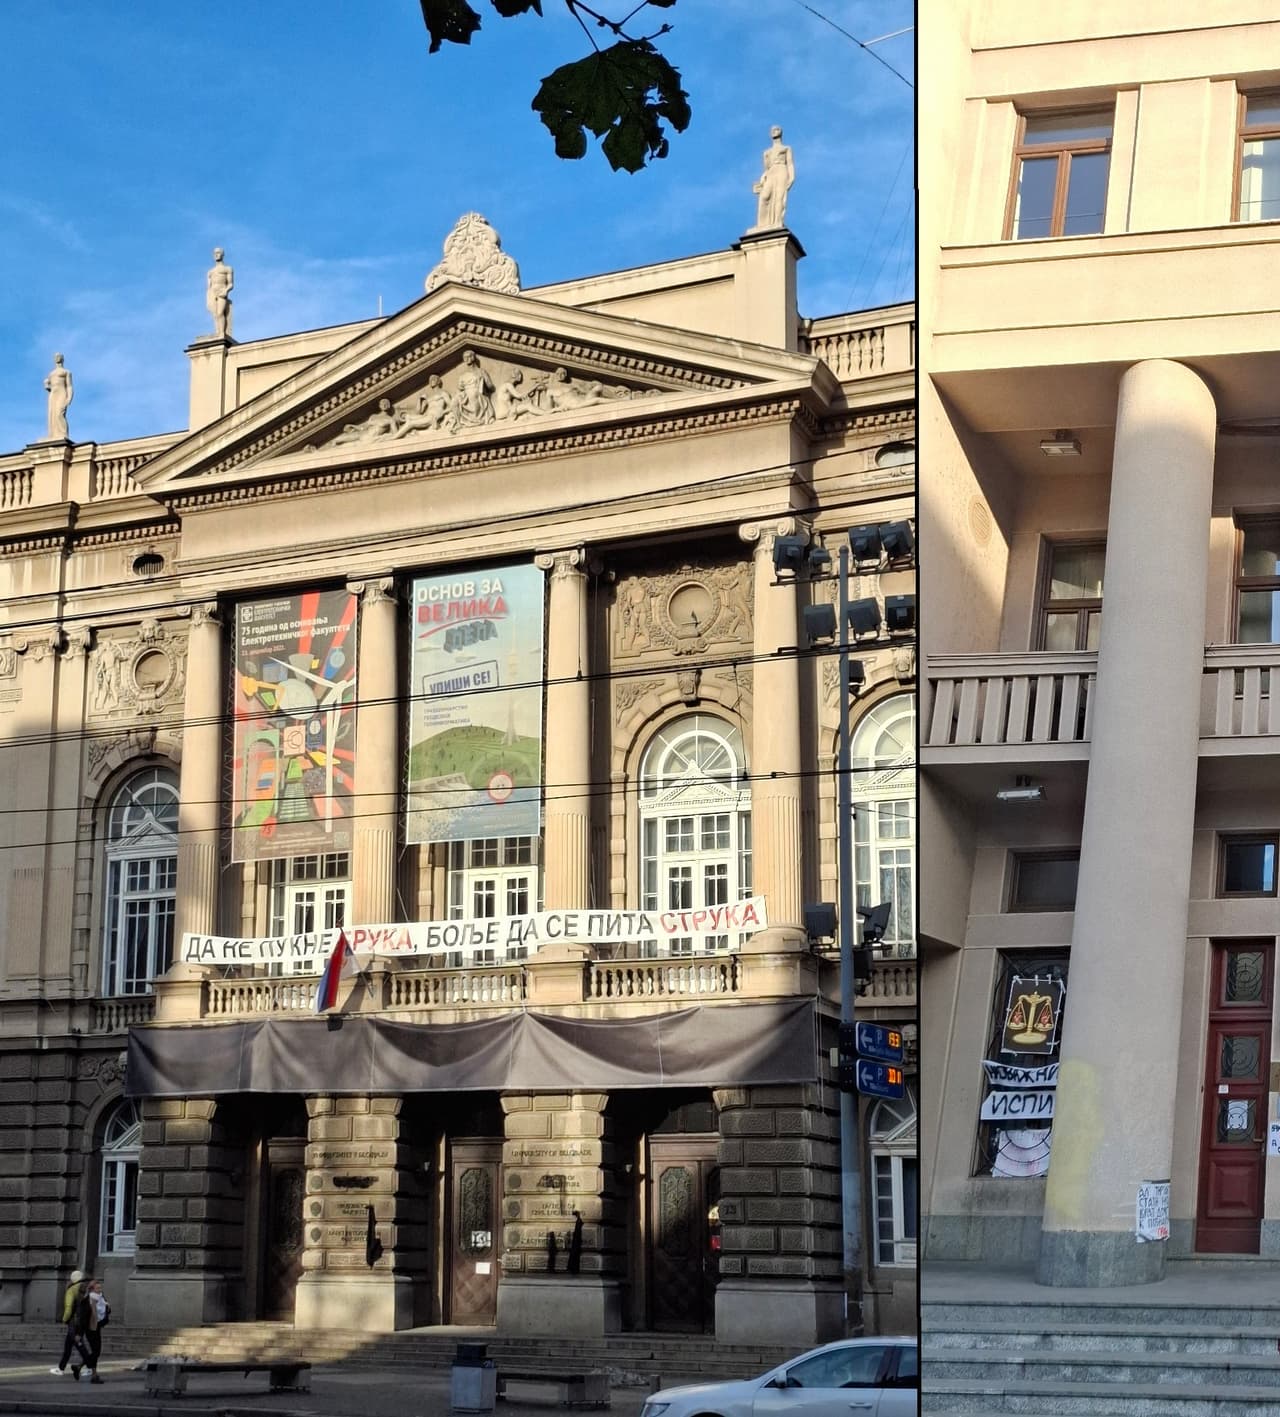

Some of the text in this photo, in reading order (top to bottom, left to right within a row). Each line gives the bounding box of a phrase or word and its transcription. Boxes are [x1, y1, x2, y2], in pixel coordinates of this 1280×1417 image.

[417, 577, 503, 602] ОСНОВ ЗА
[417, 596, 508, 623] ВЕЛИКА
[252, 622, 278, 635] година
[186, 936, 215, 962] ДА
[223, 941, 253, 958] НЕ
[344, 926, 418, 953] РУКА,
[427, 922, 500, 948] БОЉЕ
[507, 918, 539, 947] ДА
[546, 914, 578, 938] СЕ
[587, 912, 655, 937] ПИТА
[660, 903, 760, 933] СТРУКА
